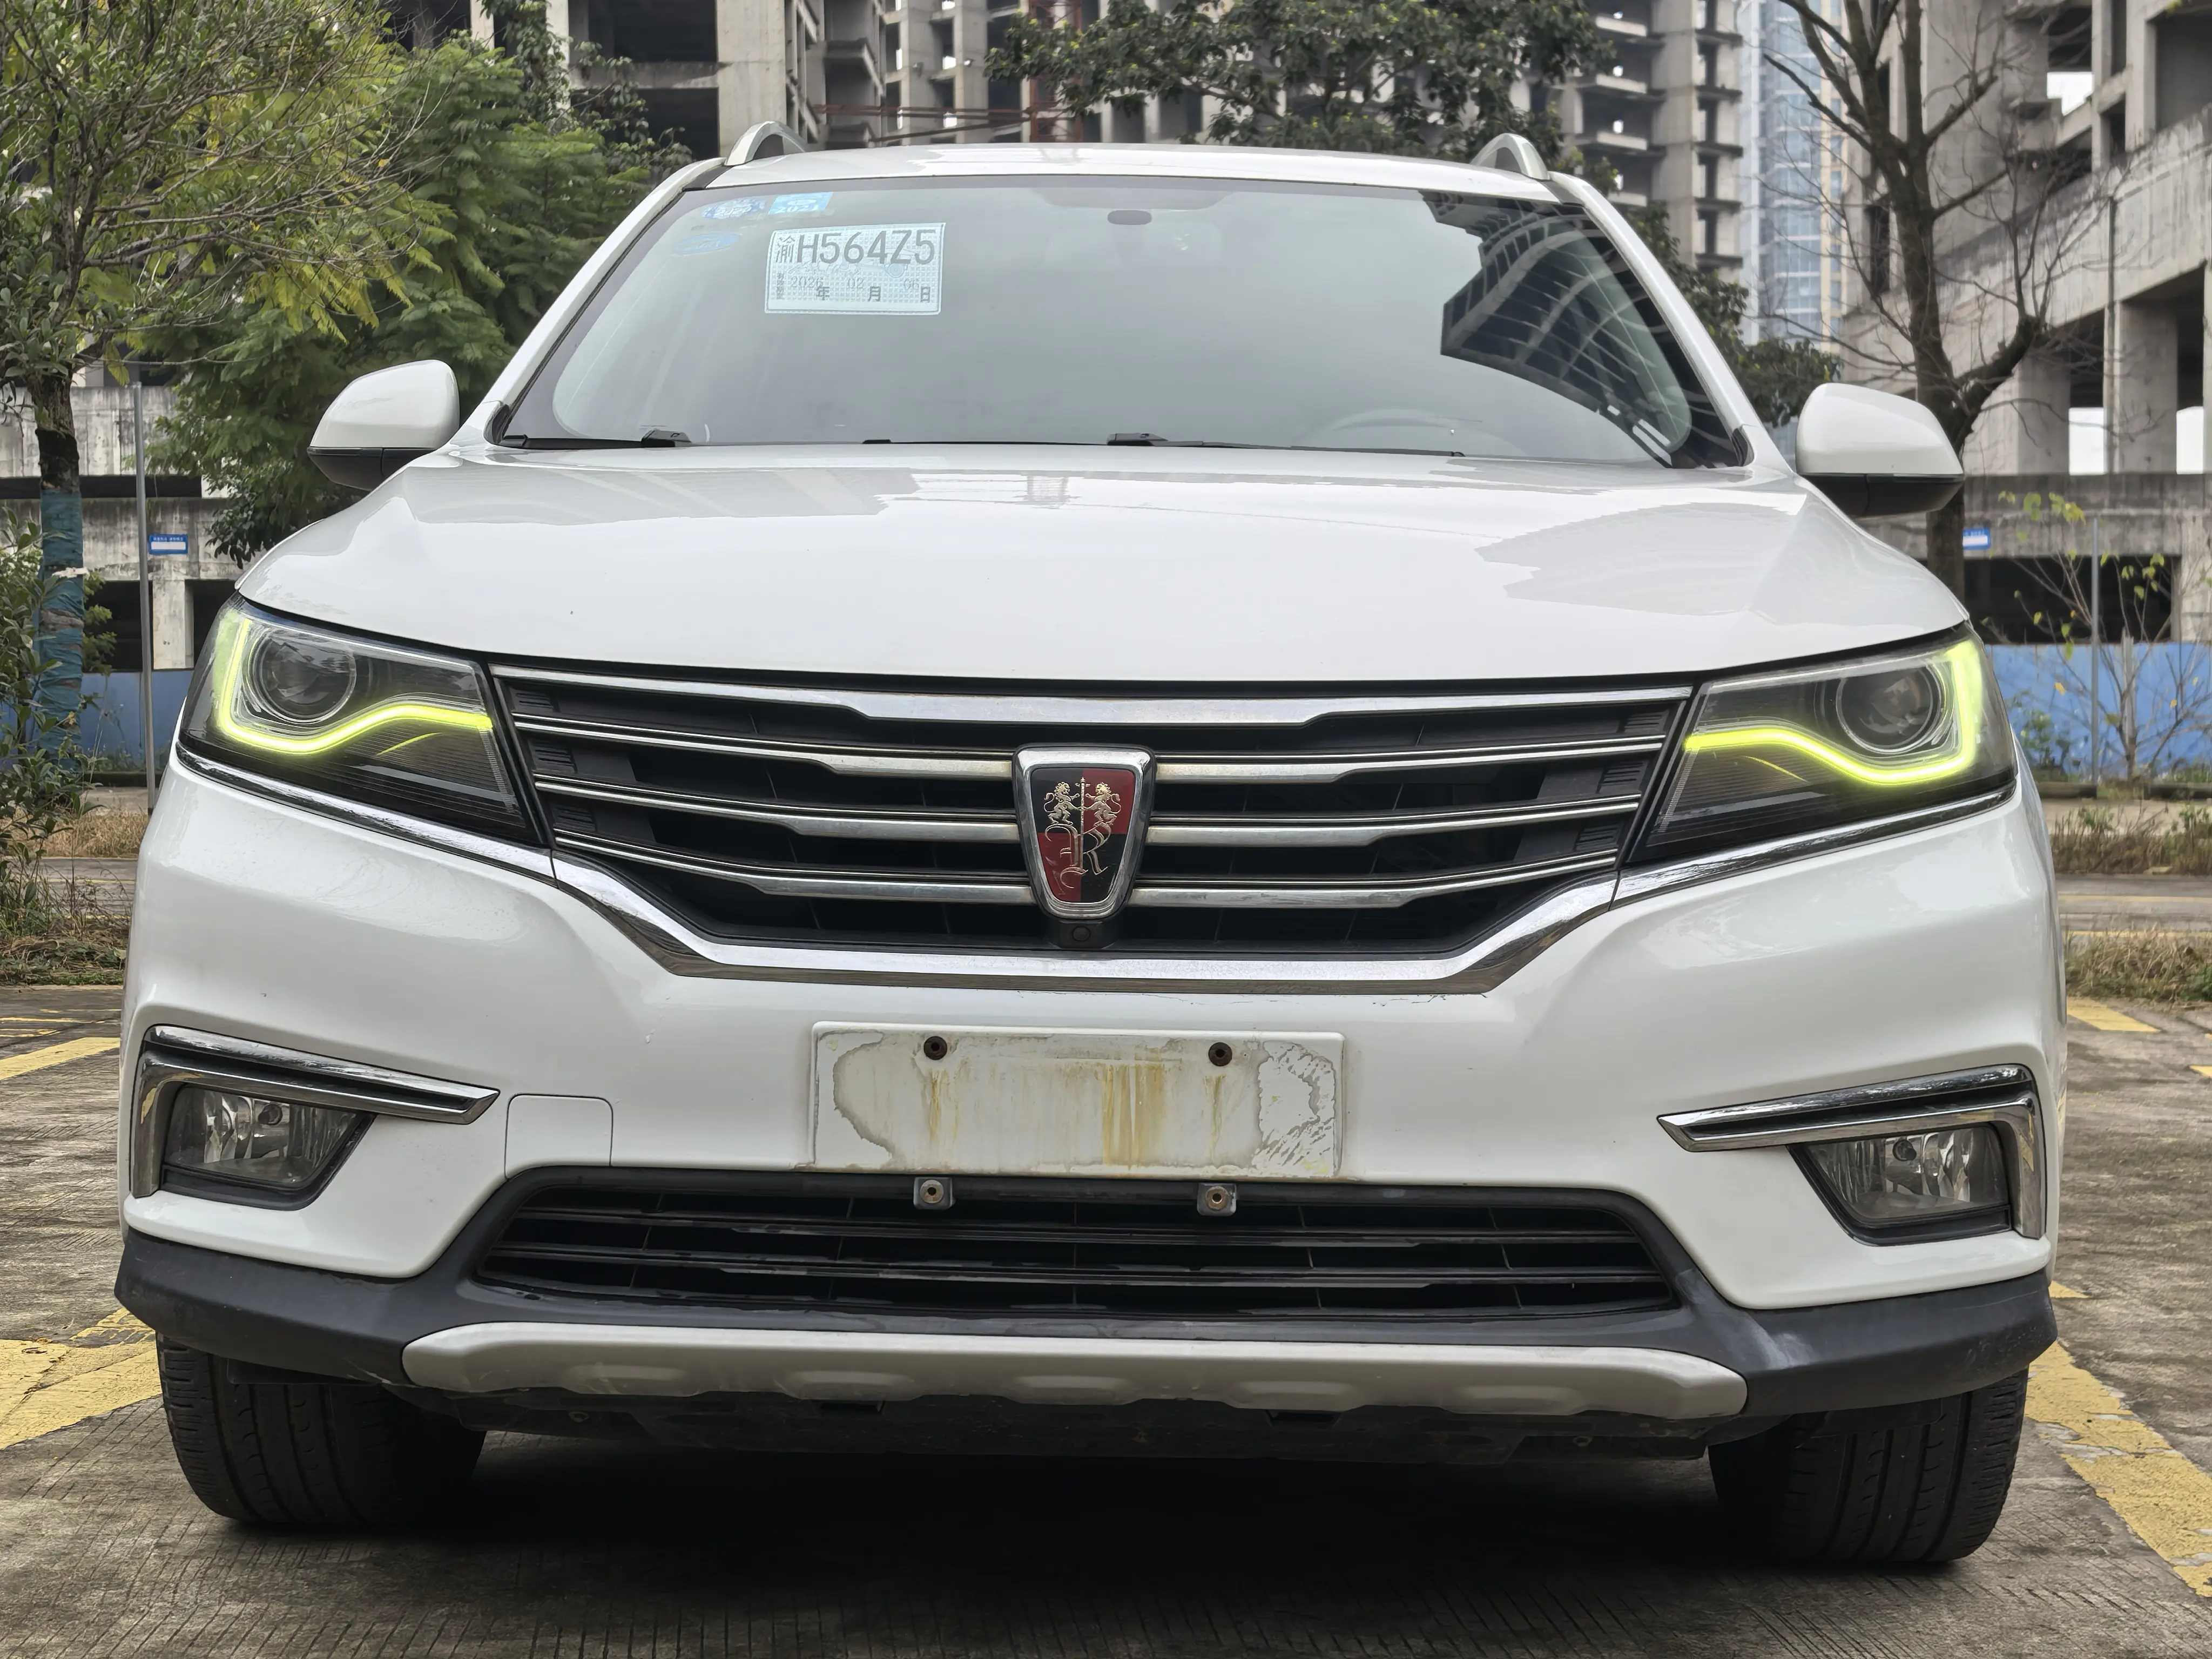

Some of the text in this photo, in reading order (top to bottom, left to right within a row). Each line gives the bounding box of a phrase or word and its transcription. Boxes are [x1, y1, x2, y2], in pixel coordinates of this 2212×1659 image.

[775, 229, 936, 265] 渝H564Z5
[815, 286, 830, 301] 年
[867, 286, 881, 302] 月
[920, 286, 931, 302] 日
